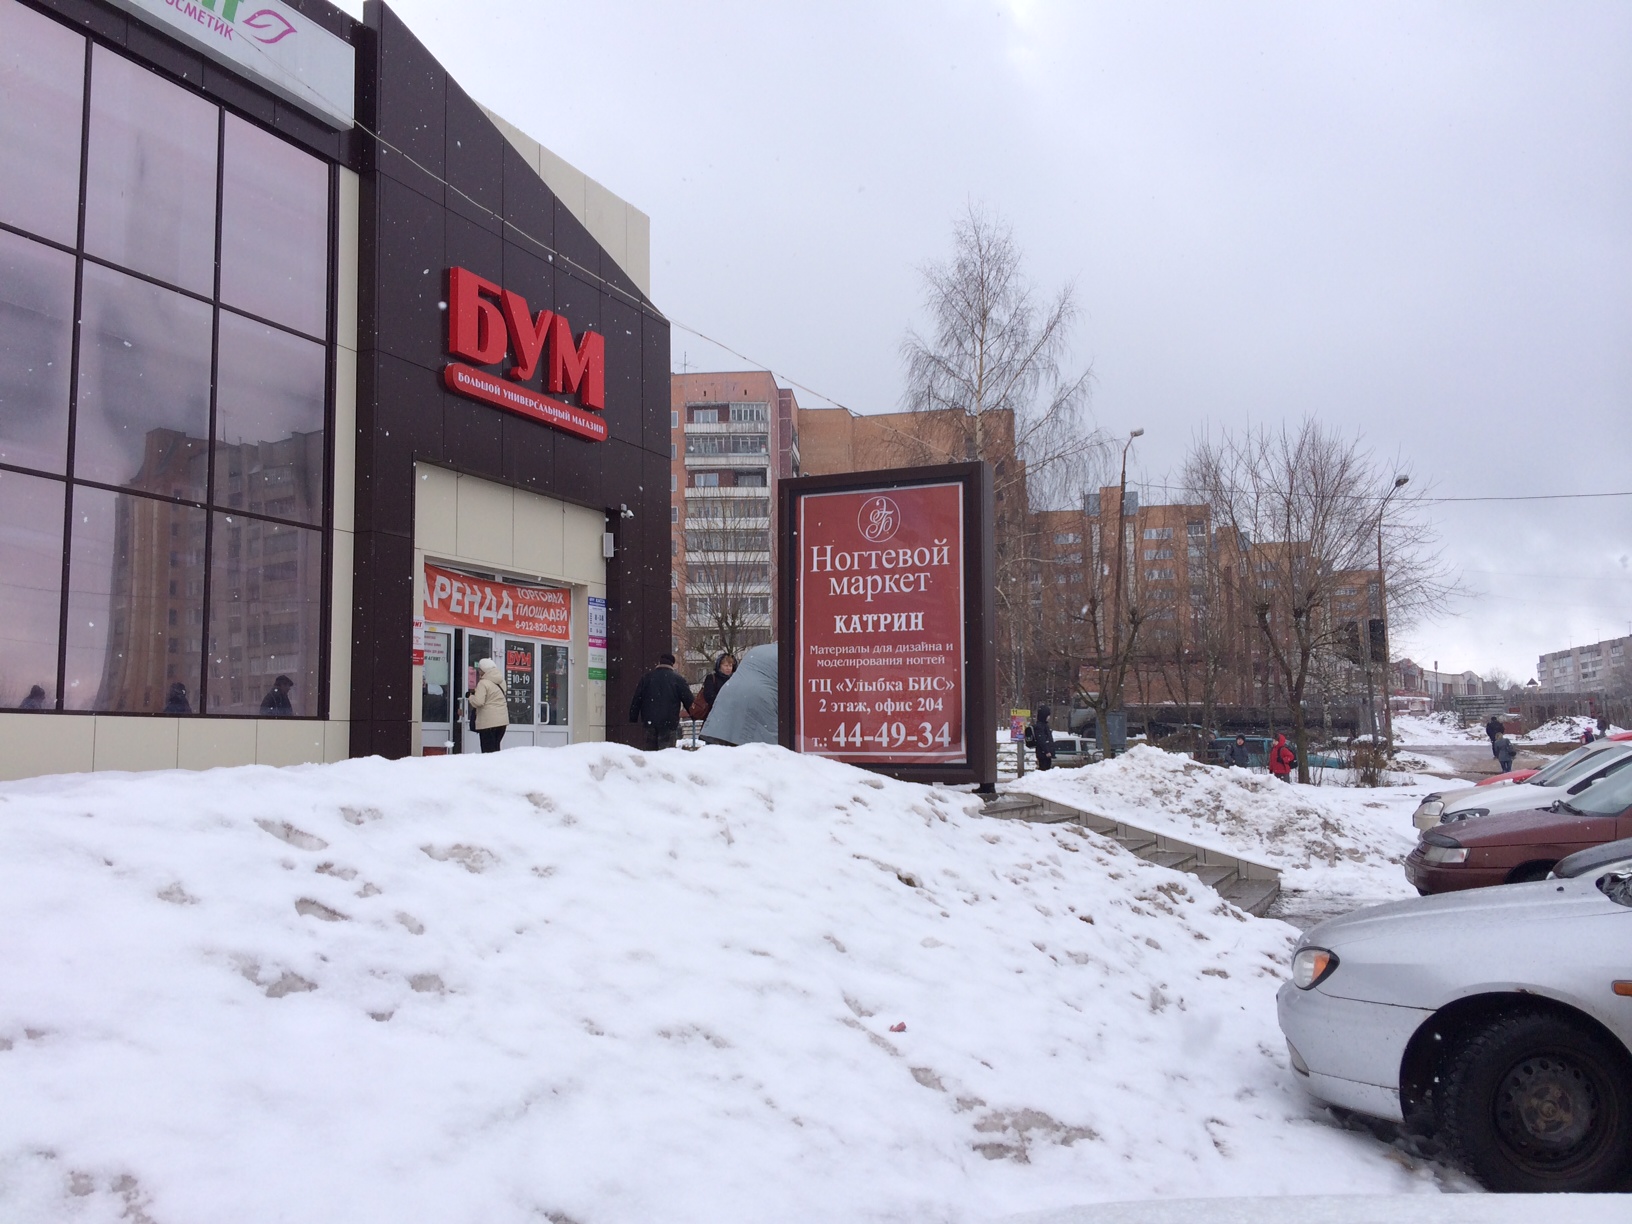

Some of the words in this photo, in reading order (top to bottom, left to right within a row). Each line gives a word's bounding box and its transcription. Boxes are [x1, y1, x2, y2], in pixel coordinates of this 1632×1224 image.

[449, 265, 605, 410] БУМ
[457, 371, 501, 395] БОЛЬШОЙ
[502, 388, 571, 422] УНИВЕРСАЛЬНЫЙ
[572, 414, 604, 434] МАГАЗИН
[810, 538, 950, 572] Ногтевой
[516, 587, 564, 604] ТОРГОВЫХ
[829, 572, 931, 602] маркет
[515, 603, 568, 622] ПЛОЩАДЕЙ
[834, 612, 925, 633] КАТРИН
[810, 645, 870, 656] Материалы
[872, 644, 892, 653] для
[895, 641, 942, 653] дизайна
[507, 650, 531, 667] БУМ
[817, 657, 902, 668] моделирования
[906, 655, 945, 665] ногтей
[512, 674, 530, 684] 10-19
[808, 679, 832, 694] ТЦ
[836, 678, 903, 692] «Улыбка
[908, 677, 955, 691] БИС»
[819, 699, 827, 712] 2
[830, 700, 871, 714] этаж,
[875, 698, 912, 715] офис
[917, 697, 943, 711] 204
[812, 737, 828, 747] т.:
[832, 721, 951, 748] 44-49-34
